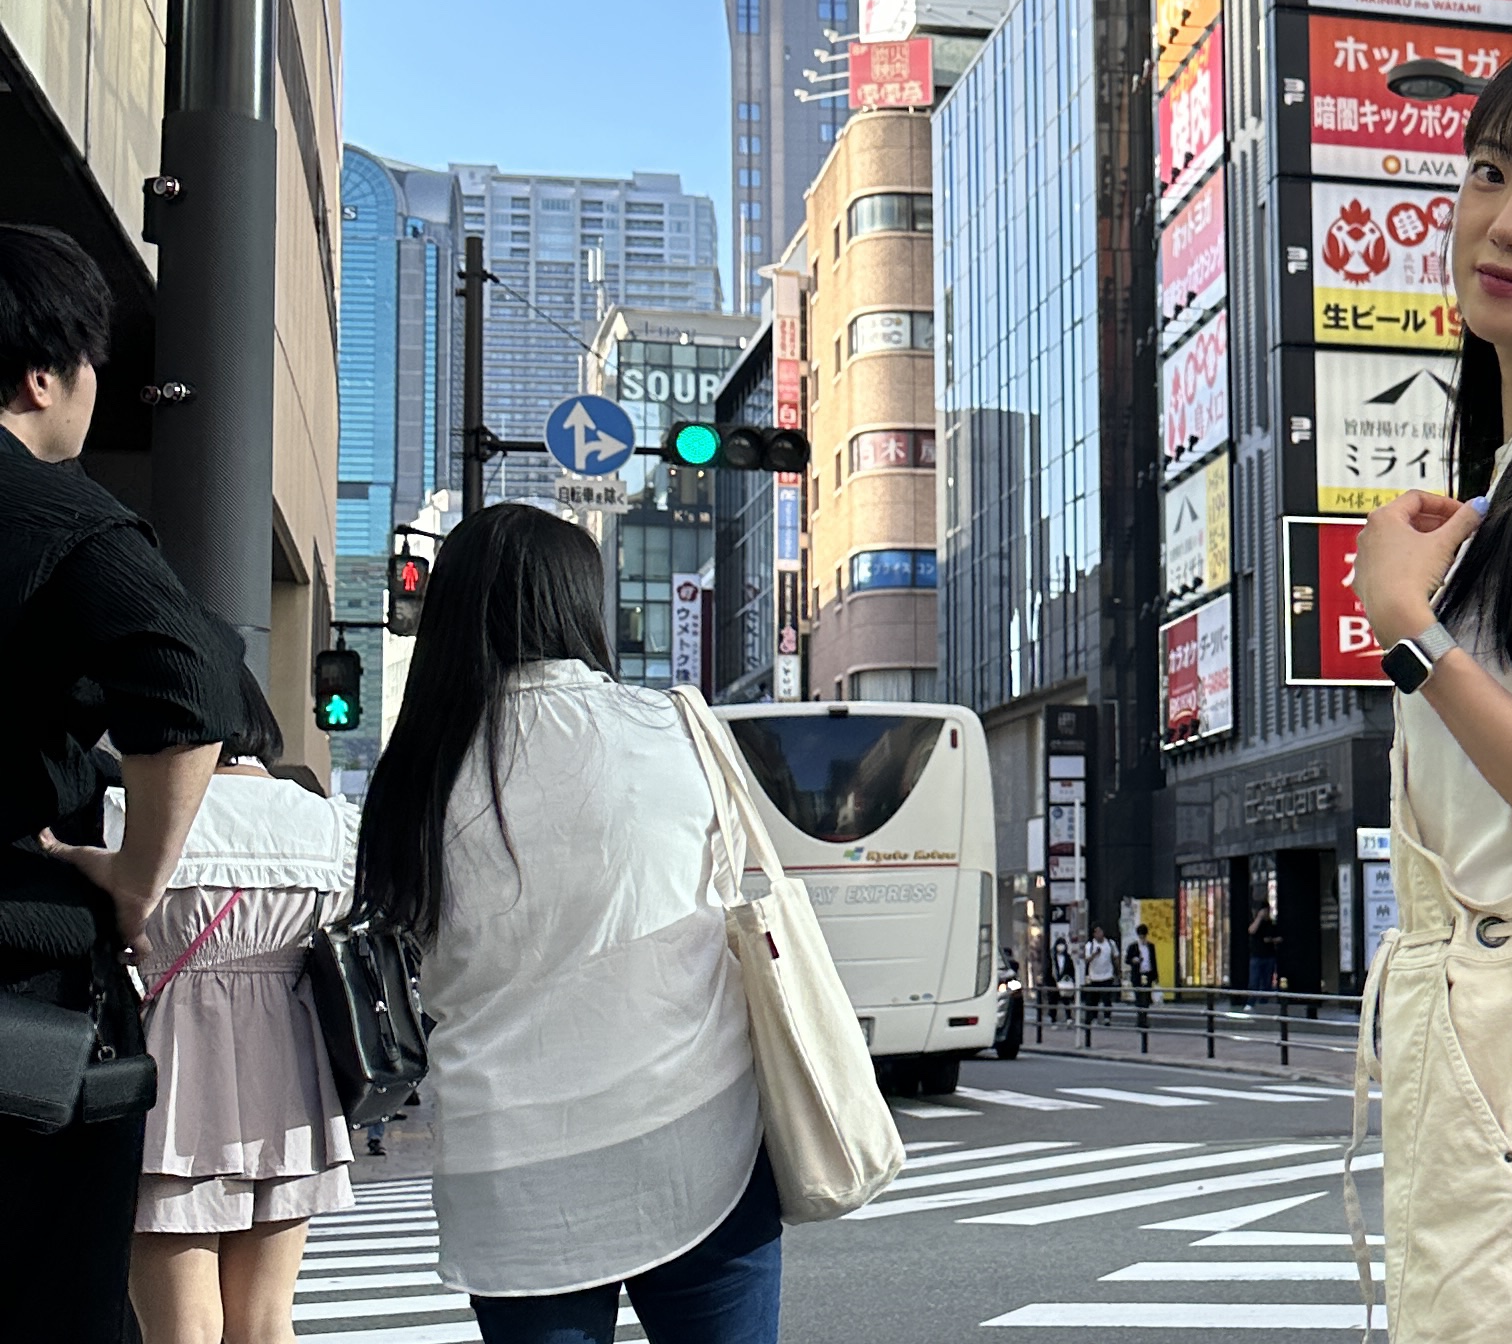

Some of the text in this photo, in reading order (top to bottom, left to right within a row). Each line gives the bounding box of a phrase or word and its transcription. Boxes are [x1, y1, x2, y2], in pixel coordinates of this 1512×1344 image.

[1313, 95, 1470, 140] 暗闇キックボク
[1405, 160, 1458, 177] LAVA
[845, 883, 938, 905] EXPRESS
